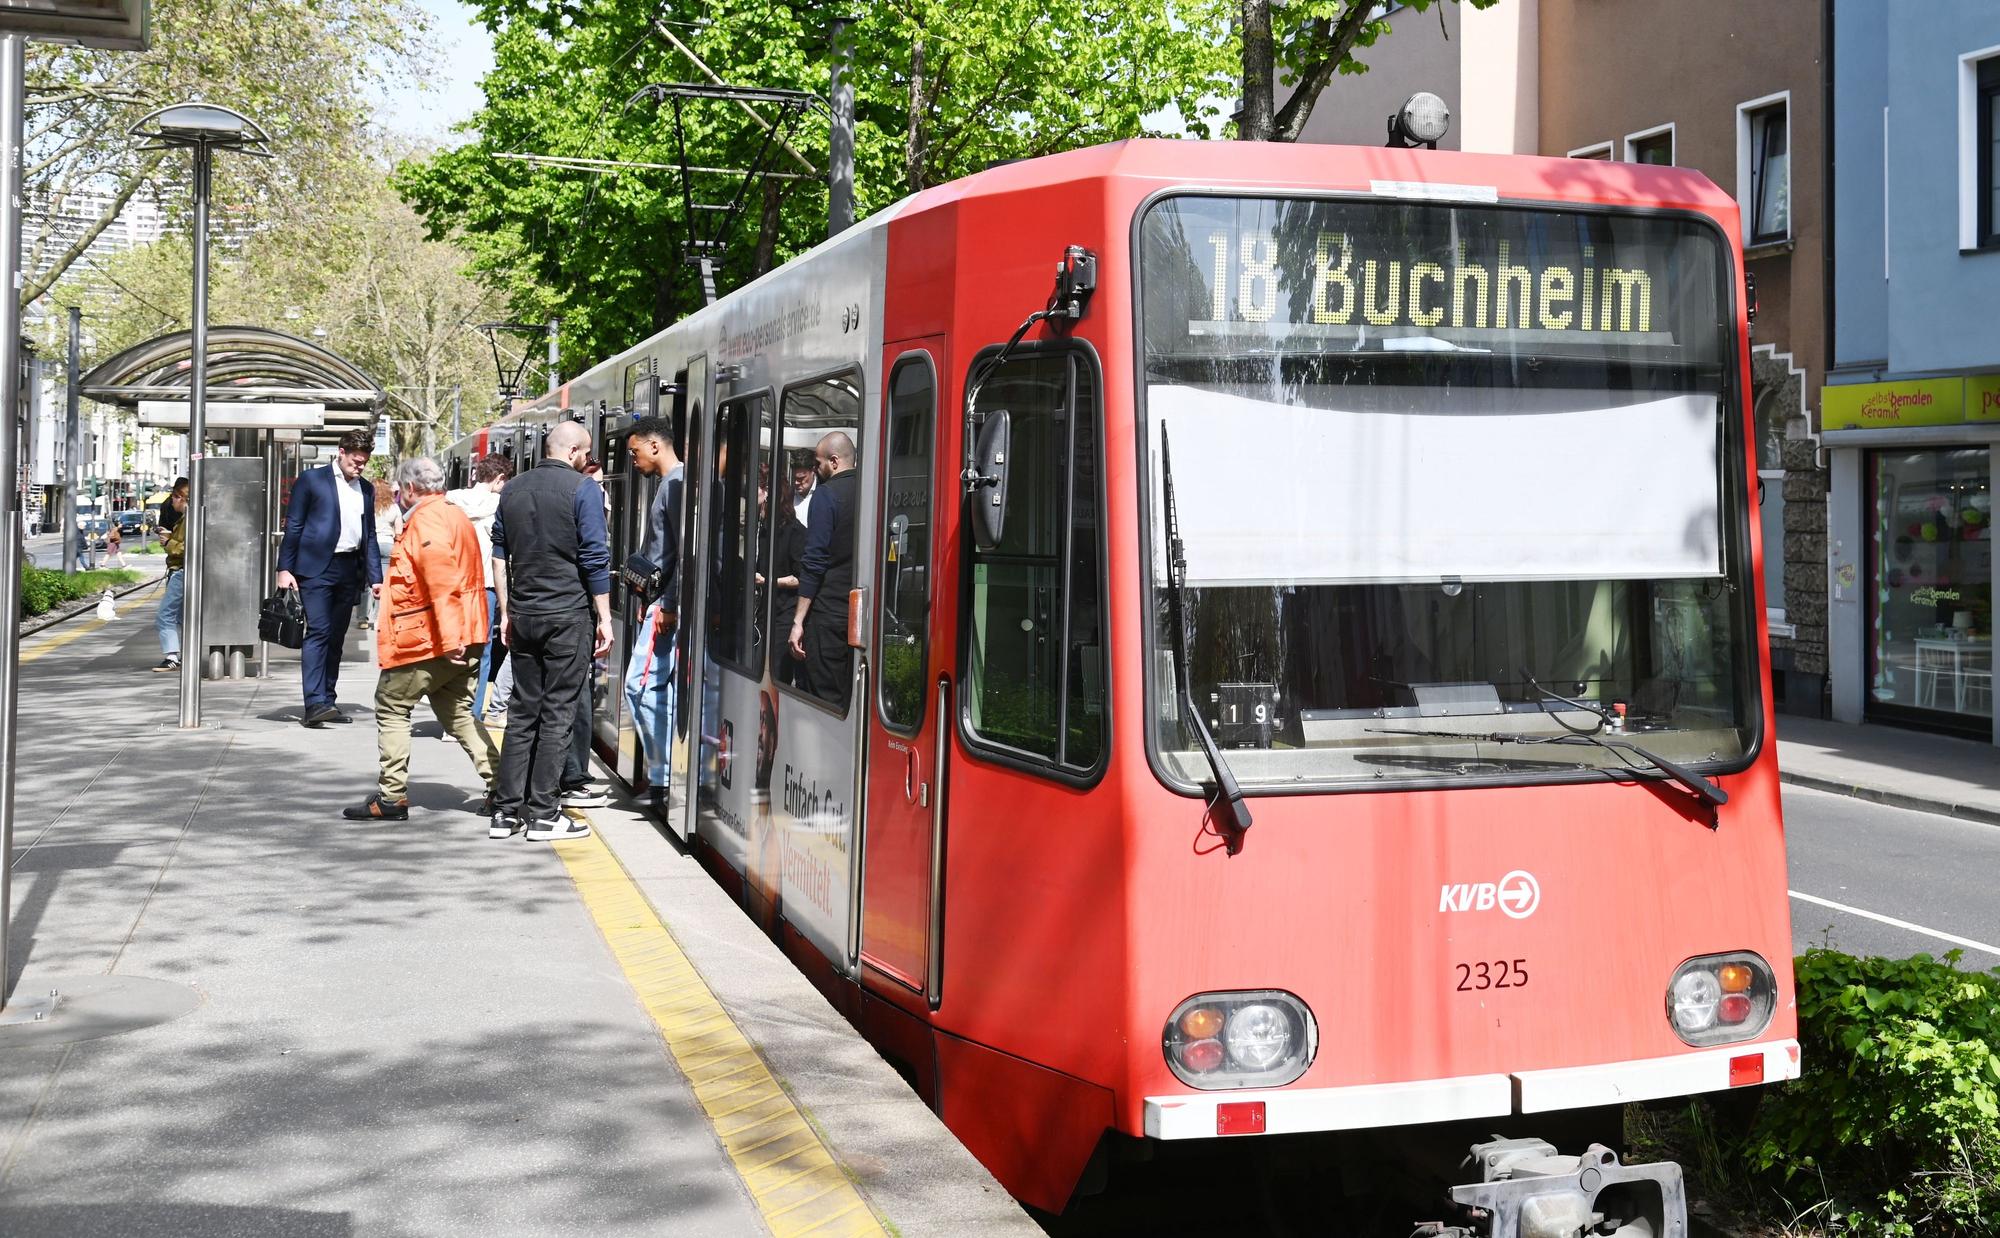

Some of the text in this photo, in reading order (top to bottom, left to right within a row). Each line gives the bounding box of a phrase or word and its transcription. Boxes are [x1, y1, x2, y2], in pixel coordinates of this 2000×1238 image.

[1208, 230, 1652, 333] 18 Buchheim
[1861, 403, 1900, 420] Keramik
[1890, 388, 1933, 407] bemalen
[782, 828, 833, 918] Vermittelt.
[1438, 882, 1497, 913] KVB
[1455, 958, 1529, 992] 2325
